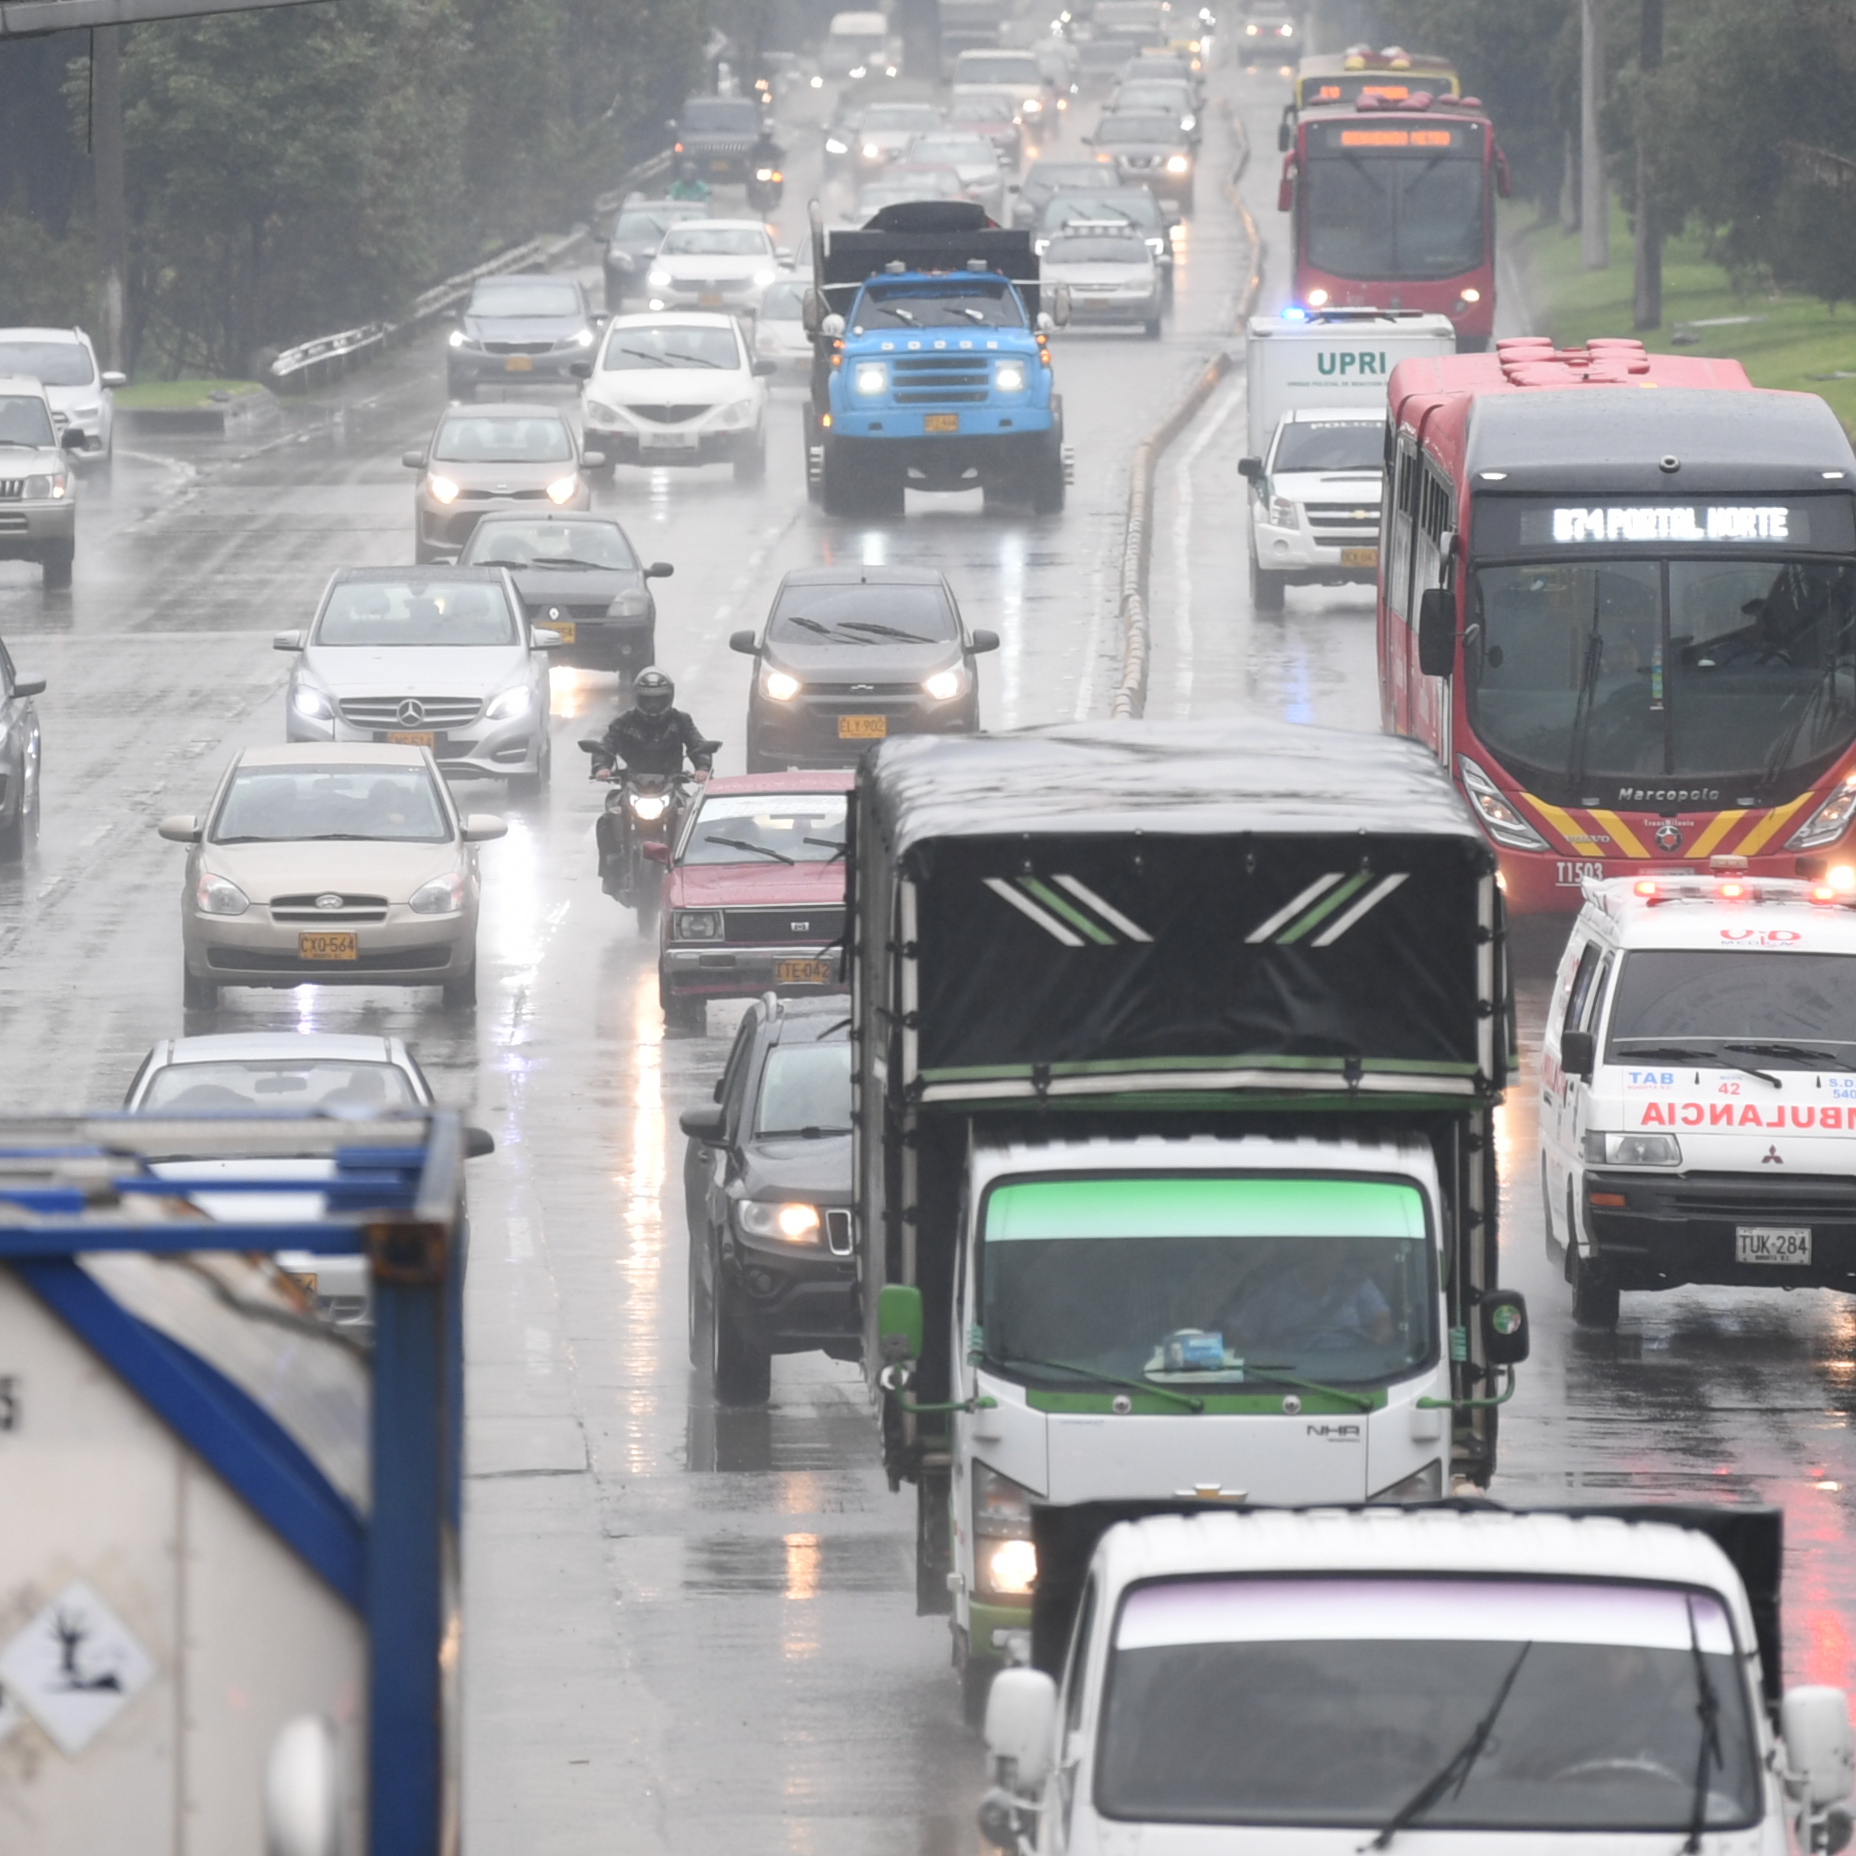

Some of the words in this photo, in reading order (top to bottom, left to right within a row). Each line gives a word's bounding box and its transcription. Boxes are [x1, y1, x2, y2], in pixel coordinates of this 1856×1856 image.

[1317, 352, 1386, 375] UPRI
[1607, 507, 1705, 540] PORTAL
[1707, 506, 1789, 538] NORTE
[1618, 787, 1720, 802] Marcopolo
[1556, 862, 1603, 882] T1503
[1628, 1071, 1675, 1085] TAB
[1718, 1082, 1741, 1095] 42
